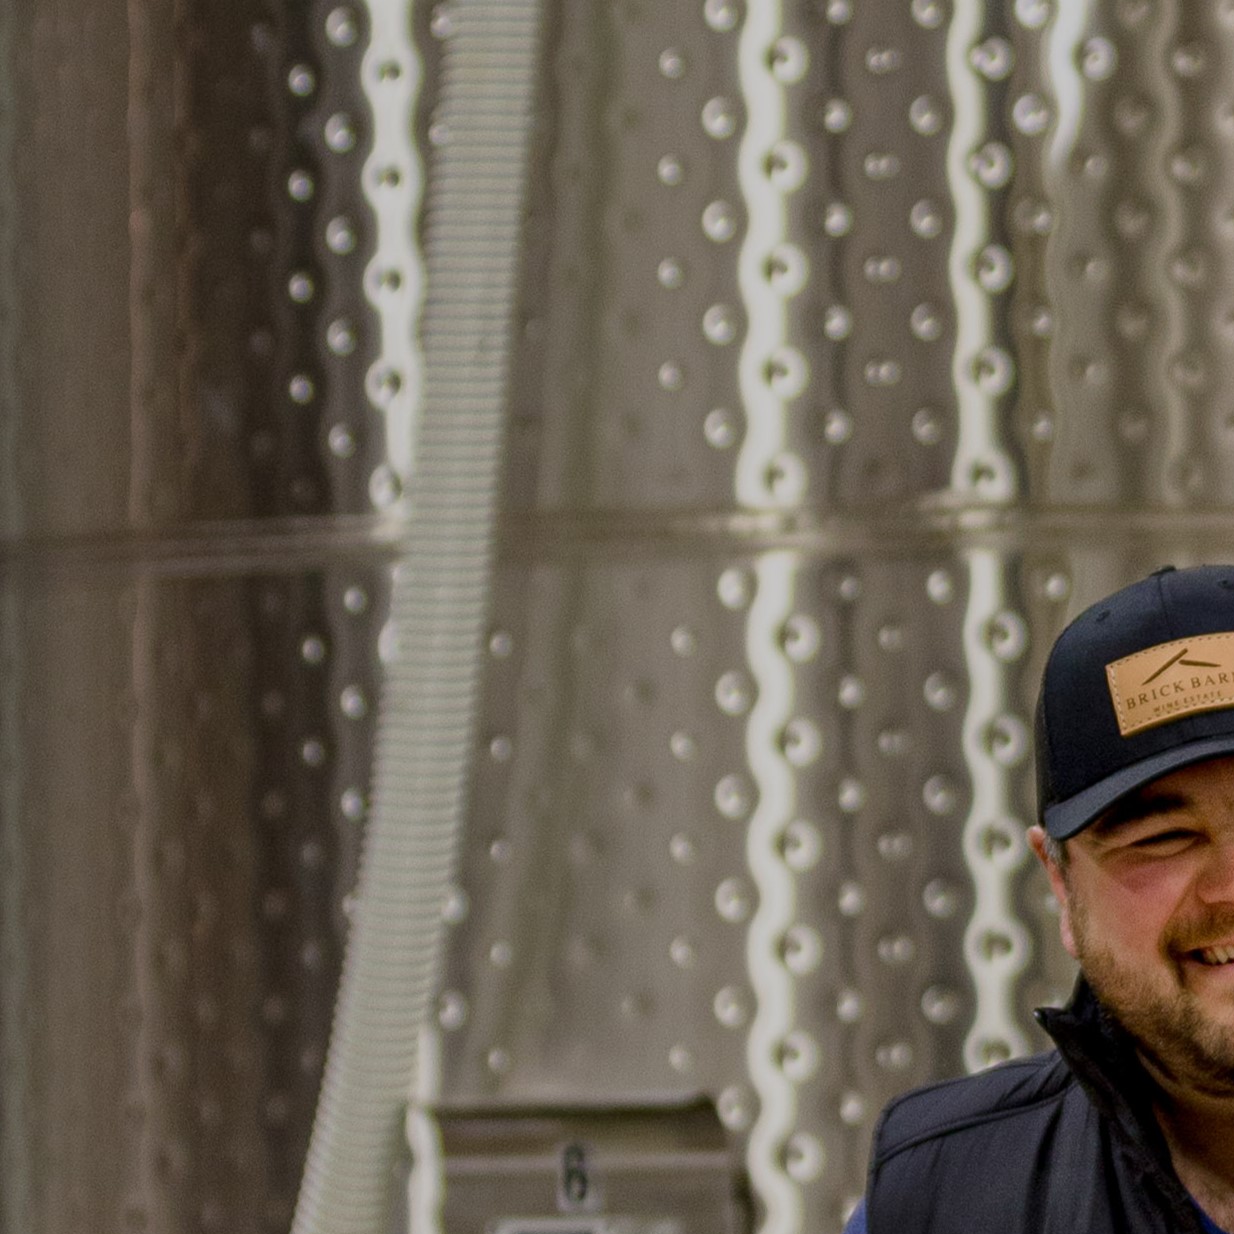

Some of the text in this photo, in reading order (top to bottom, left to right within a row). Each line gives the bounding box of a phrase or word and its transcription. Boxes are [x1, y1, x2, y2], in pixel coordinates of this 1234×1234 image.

[1126, 680, 1185, 710] BRICK
[1153, 690, 1222, 713] WINE ESTATE
